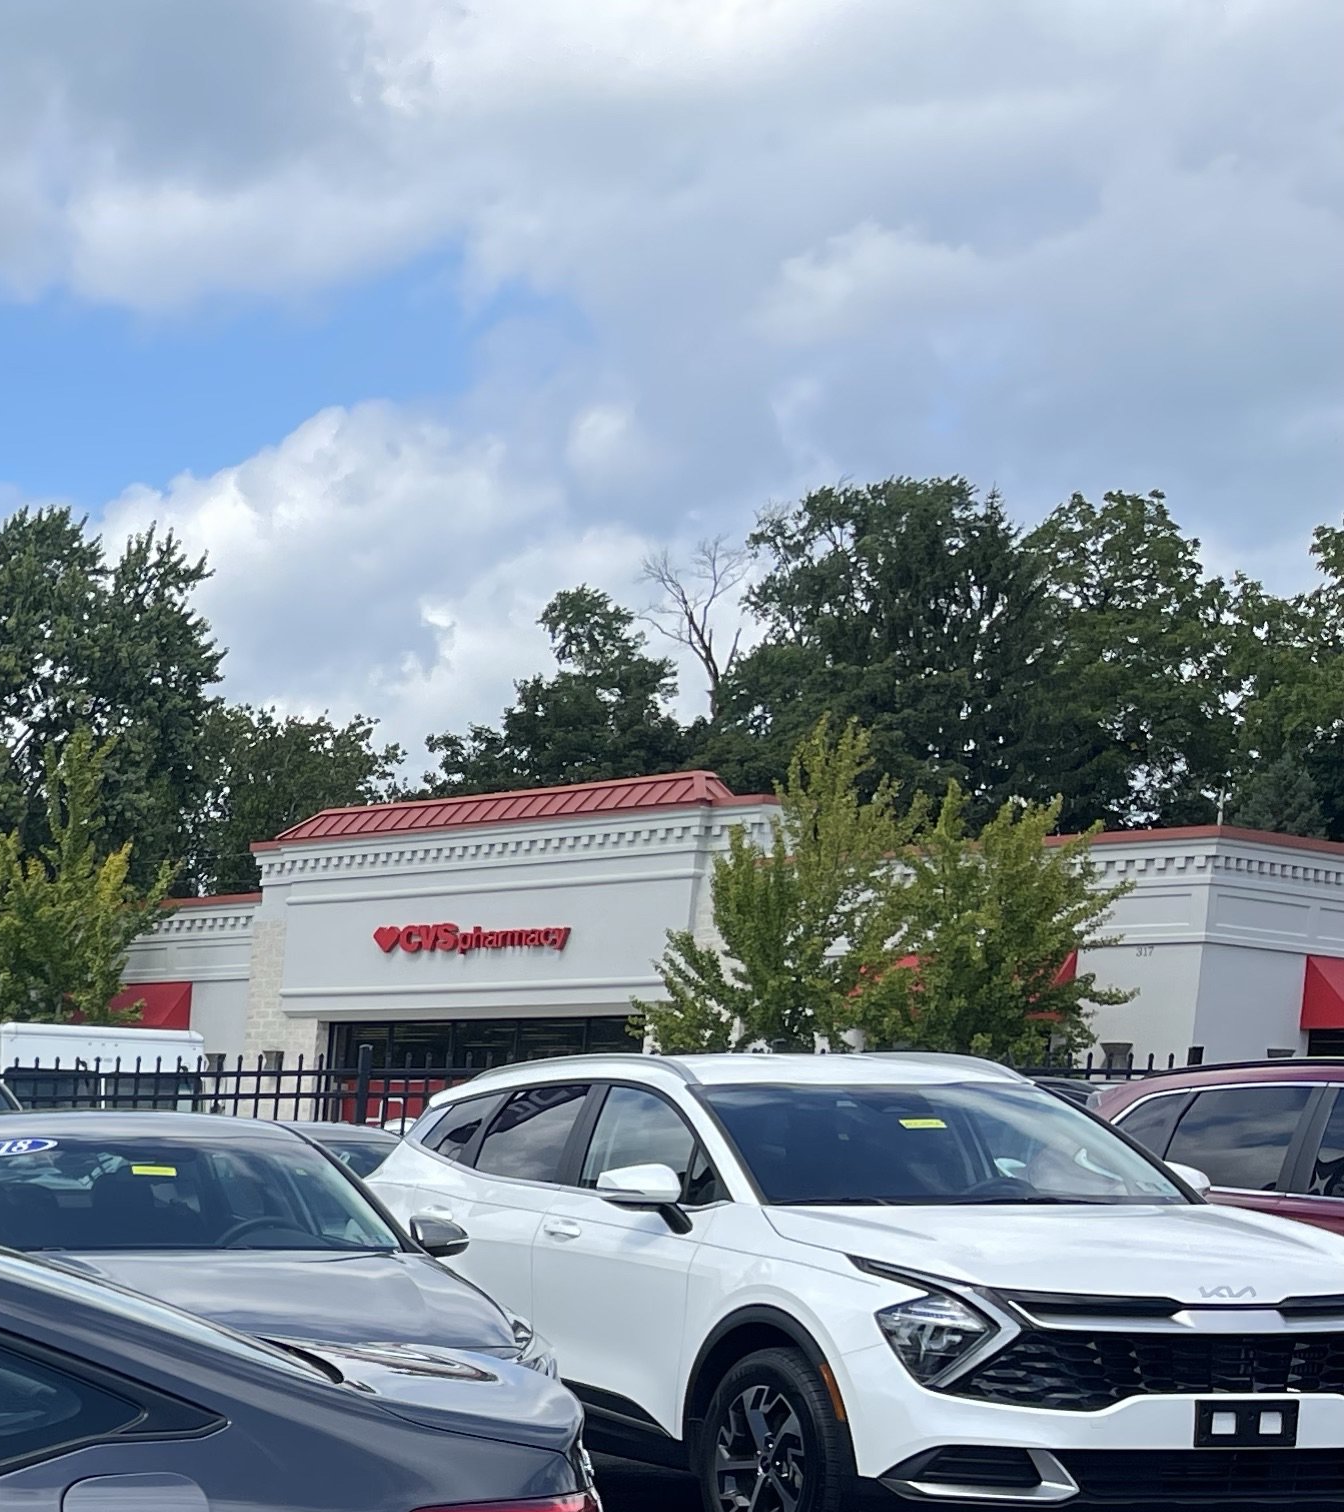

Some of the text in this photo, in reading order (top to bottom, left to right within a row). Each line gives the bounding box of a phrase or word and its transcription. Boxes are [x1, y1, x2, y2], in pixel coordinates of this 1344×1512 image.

[399, 923, 572, 955] CVS pharmacy
[1135, 945, 1155, 958] 317
